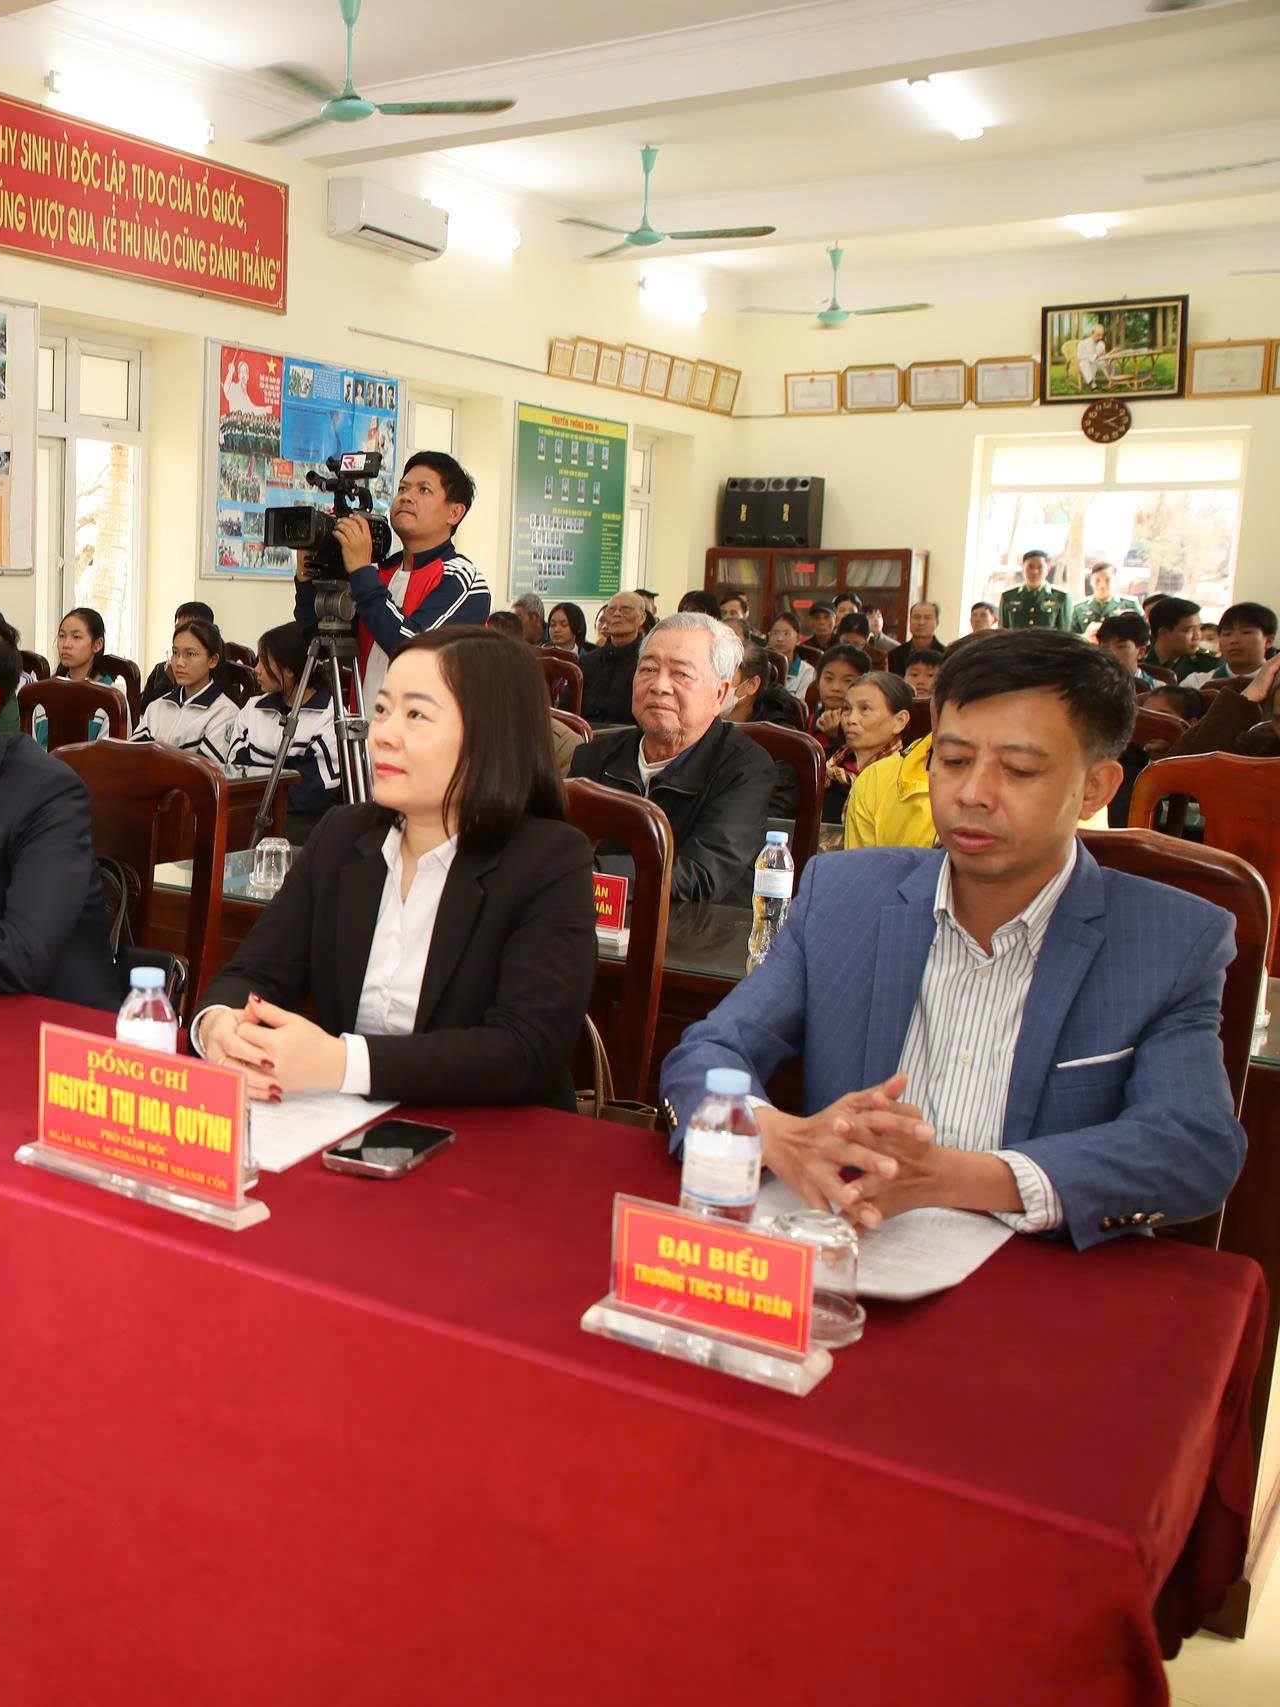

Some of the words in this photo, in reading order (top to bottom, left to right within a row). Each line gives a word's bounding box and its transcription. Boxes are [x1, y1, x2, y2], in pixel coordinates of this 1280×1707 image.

[0, 125, 18, 166] HY
[20, 131, 51, 176] SINH
[55, 130, 68, 181] VÌ
[71, 139, 101, 194] ĐỘC
[104, 148, 128, 202] LẬP,
[132, 163, 145, 209] TỰ
[148, 167, 166, 207] DO
[169, 164, 193, 215] CỦA
[195, 168, 209, 219] TỔ
[212, 180, 247, 234] QUỐC,
[29, 196, 65, 248] VƯỢT
[67, 207, 99, 255] QUA,
[103, 204, 117, 253] KẺ
[120, 211, 141, 259] THÙ
[144, 216, 170, 266] NÀO
[173, 227, 207, 274] CŨNG
[209, 234, 240, 282] ĐÁNH
[150, 1066, 188, 1092] CHÍ
[111, 1087, 135, 1134] THỊ
[138, 1095, 171, 1137] HOA
[657, 1234, 701, 1268] ĐẠI
